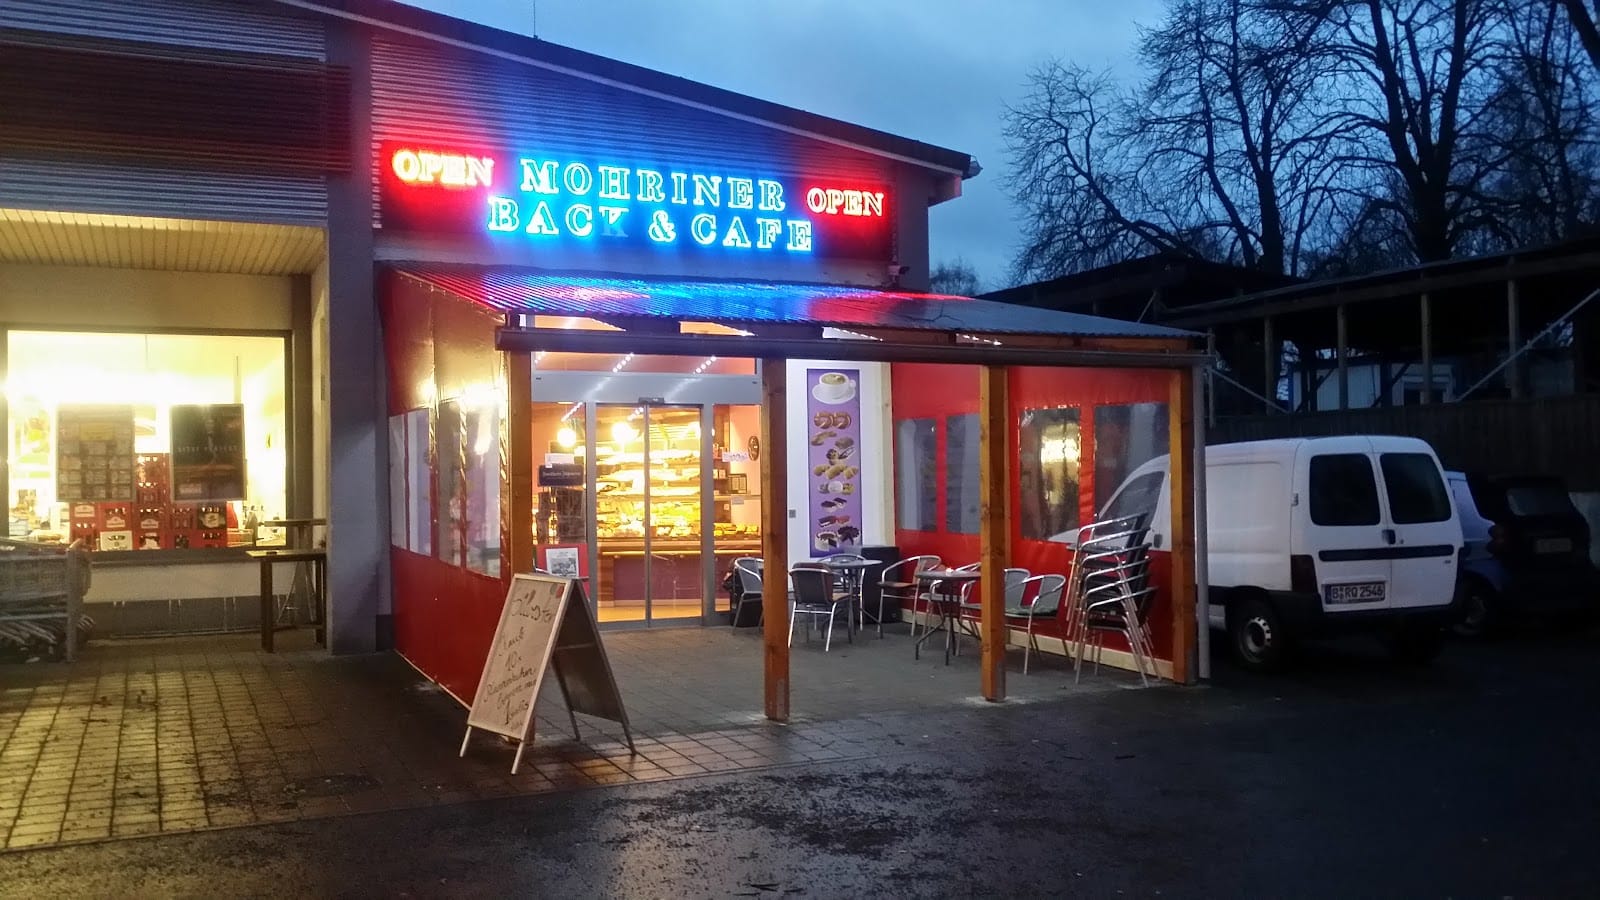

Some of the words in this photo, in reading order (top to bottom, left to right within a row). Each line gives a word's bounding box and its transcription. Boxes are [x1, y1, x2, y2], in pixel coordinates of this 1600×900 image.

[391, 149, 494, 187] OPEN
[520, 158, 785, 212] MOHRINER
[487, 196, 629, 238] BACK
[648, 209, 677, 243] &
[691, 213, 812, 252] CAFE
[806, 188, 884, 217] OPEN
